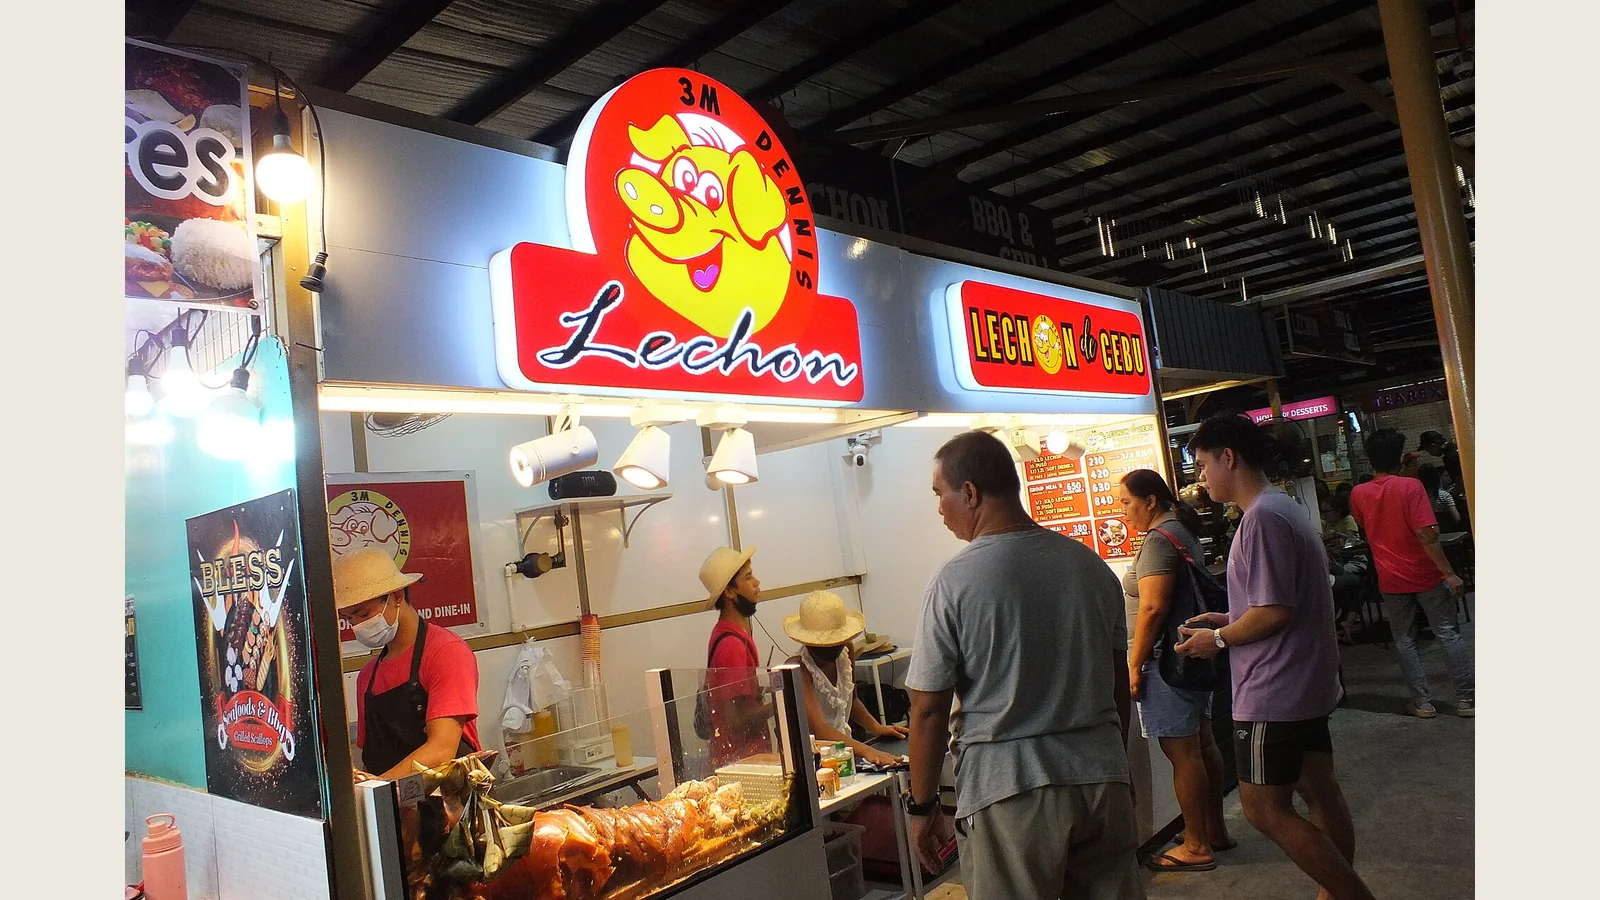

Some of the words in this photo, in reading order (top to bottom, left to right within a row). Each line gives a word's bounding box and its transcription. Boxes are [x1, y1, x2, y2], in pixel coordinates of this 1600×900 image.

[677, 77, 721, 116] 3M
[754, 129, 814, 291] DENNIS
[538, 282, 858, 387] Lechon
[1079, 314, 1098, 364] de
[1099, 328, 1147, 377] CEBU
[1290, 404, 1329, 417] DESSERTS
[1088, 455, 1105, 467] 210
[1090, 467, 1110, 480] 420
[1066, 481, 1082, 492] 650
[1092, 481, 1111, 494] 630
[1094, 495, 1114, 507] 840
[351, 490, 370, 502] 3M
[384, 500, 410, 557] DENNIS
[1072, 523, 1088, 533] 380
[201, 548, 285, 597] BLESS
[434, 603, 471, 618] DINE-IN
[222, 697, 256, 728] Seafoods
[257, 700, 266, 718] &
[267, 706, 287, 744] Bbq
[233, 730, 251, 743] Grilled
[251, 732, 273, 749] Scallops
